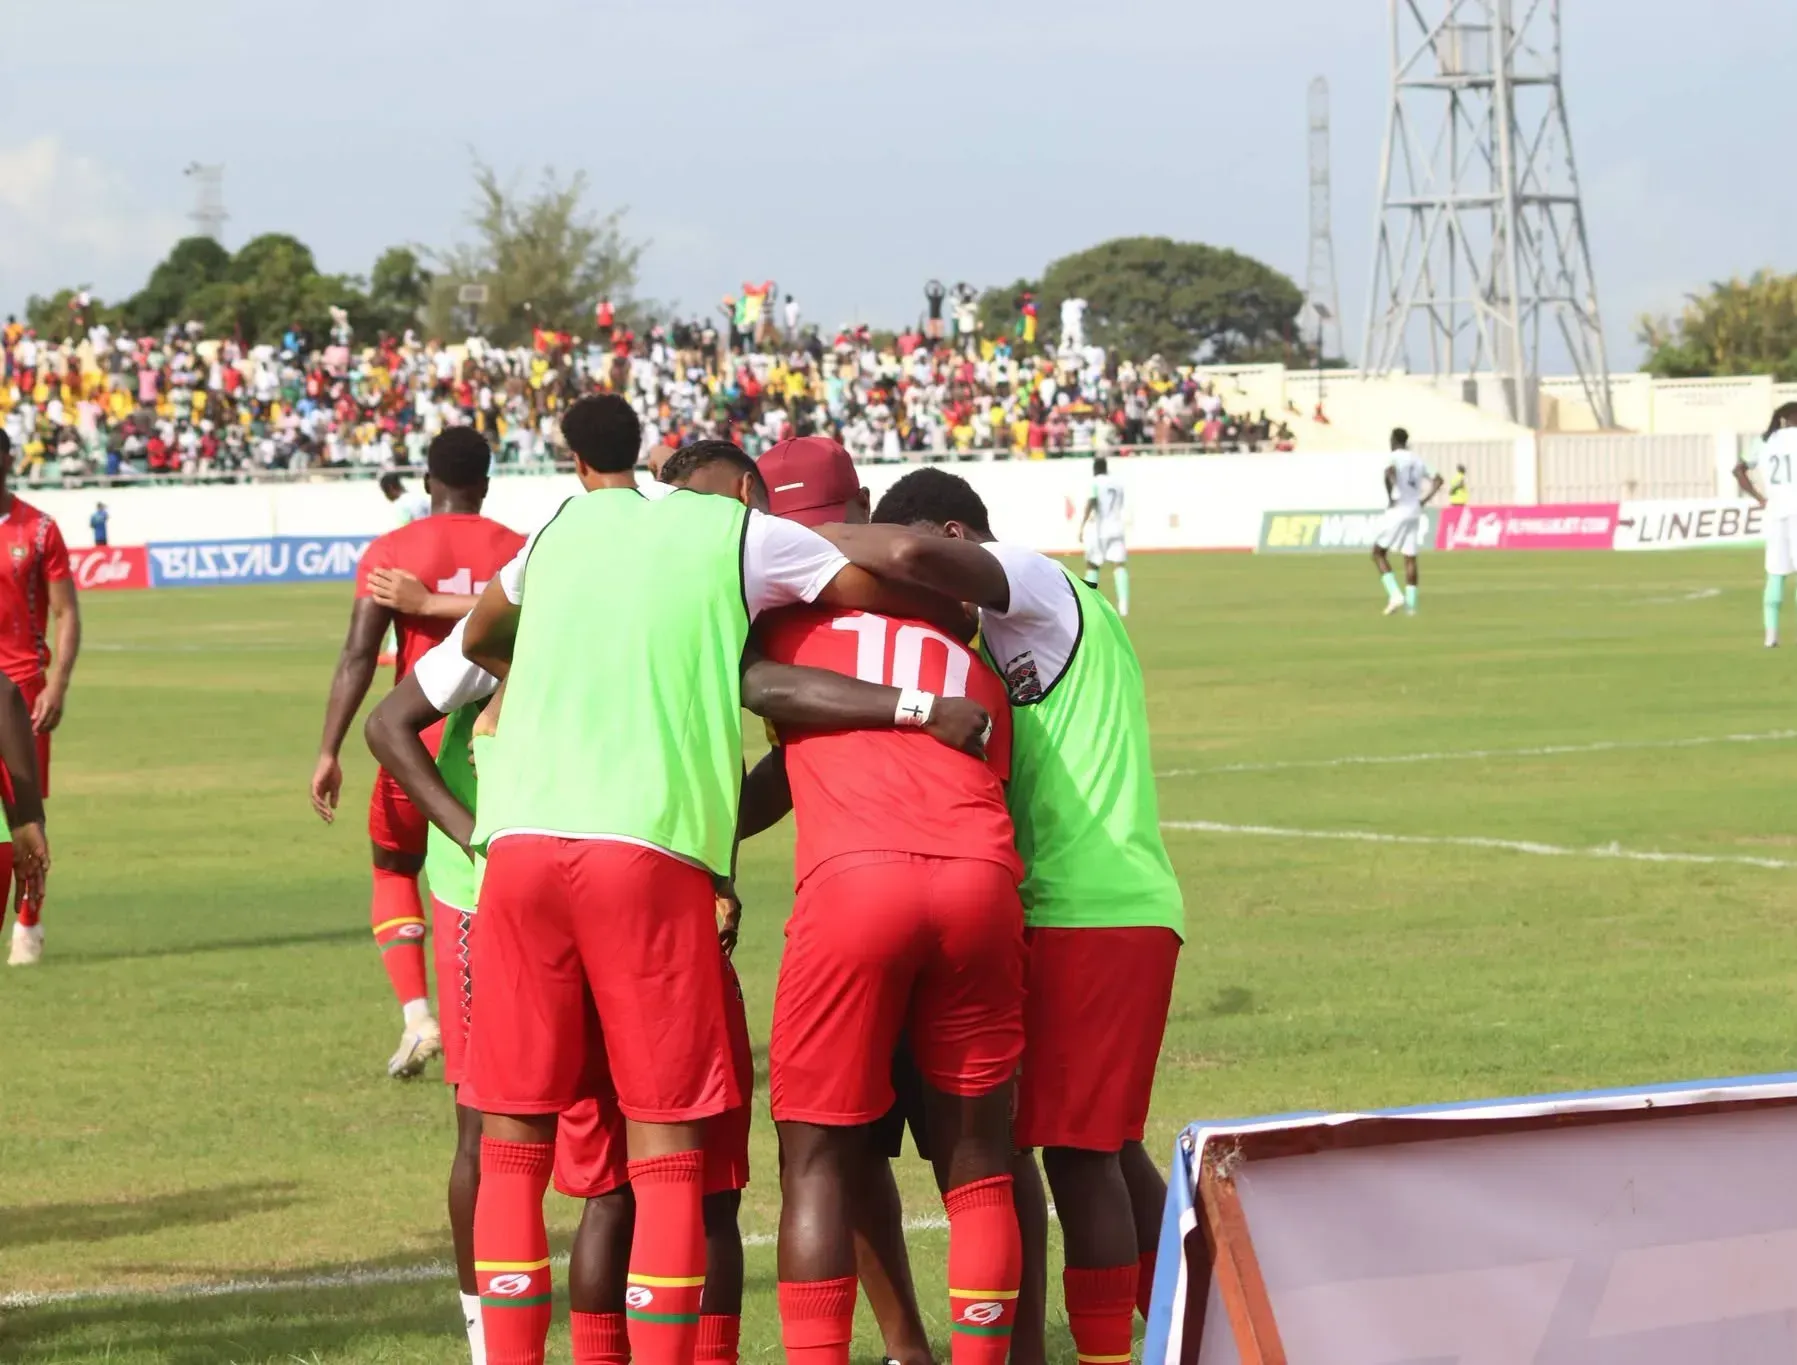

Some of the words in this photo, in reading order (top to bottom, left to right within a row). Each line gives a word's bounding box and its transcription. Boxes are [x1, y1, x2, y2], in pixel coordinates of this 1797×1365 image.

[1768, 454, 1793, 485] 21
[151, 542, 290, 579] BISSAU
[831, 612, 971, 698] 10
